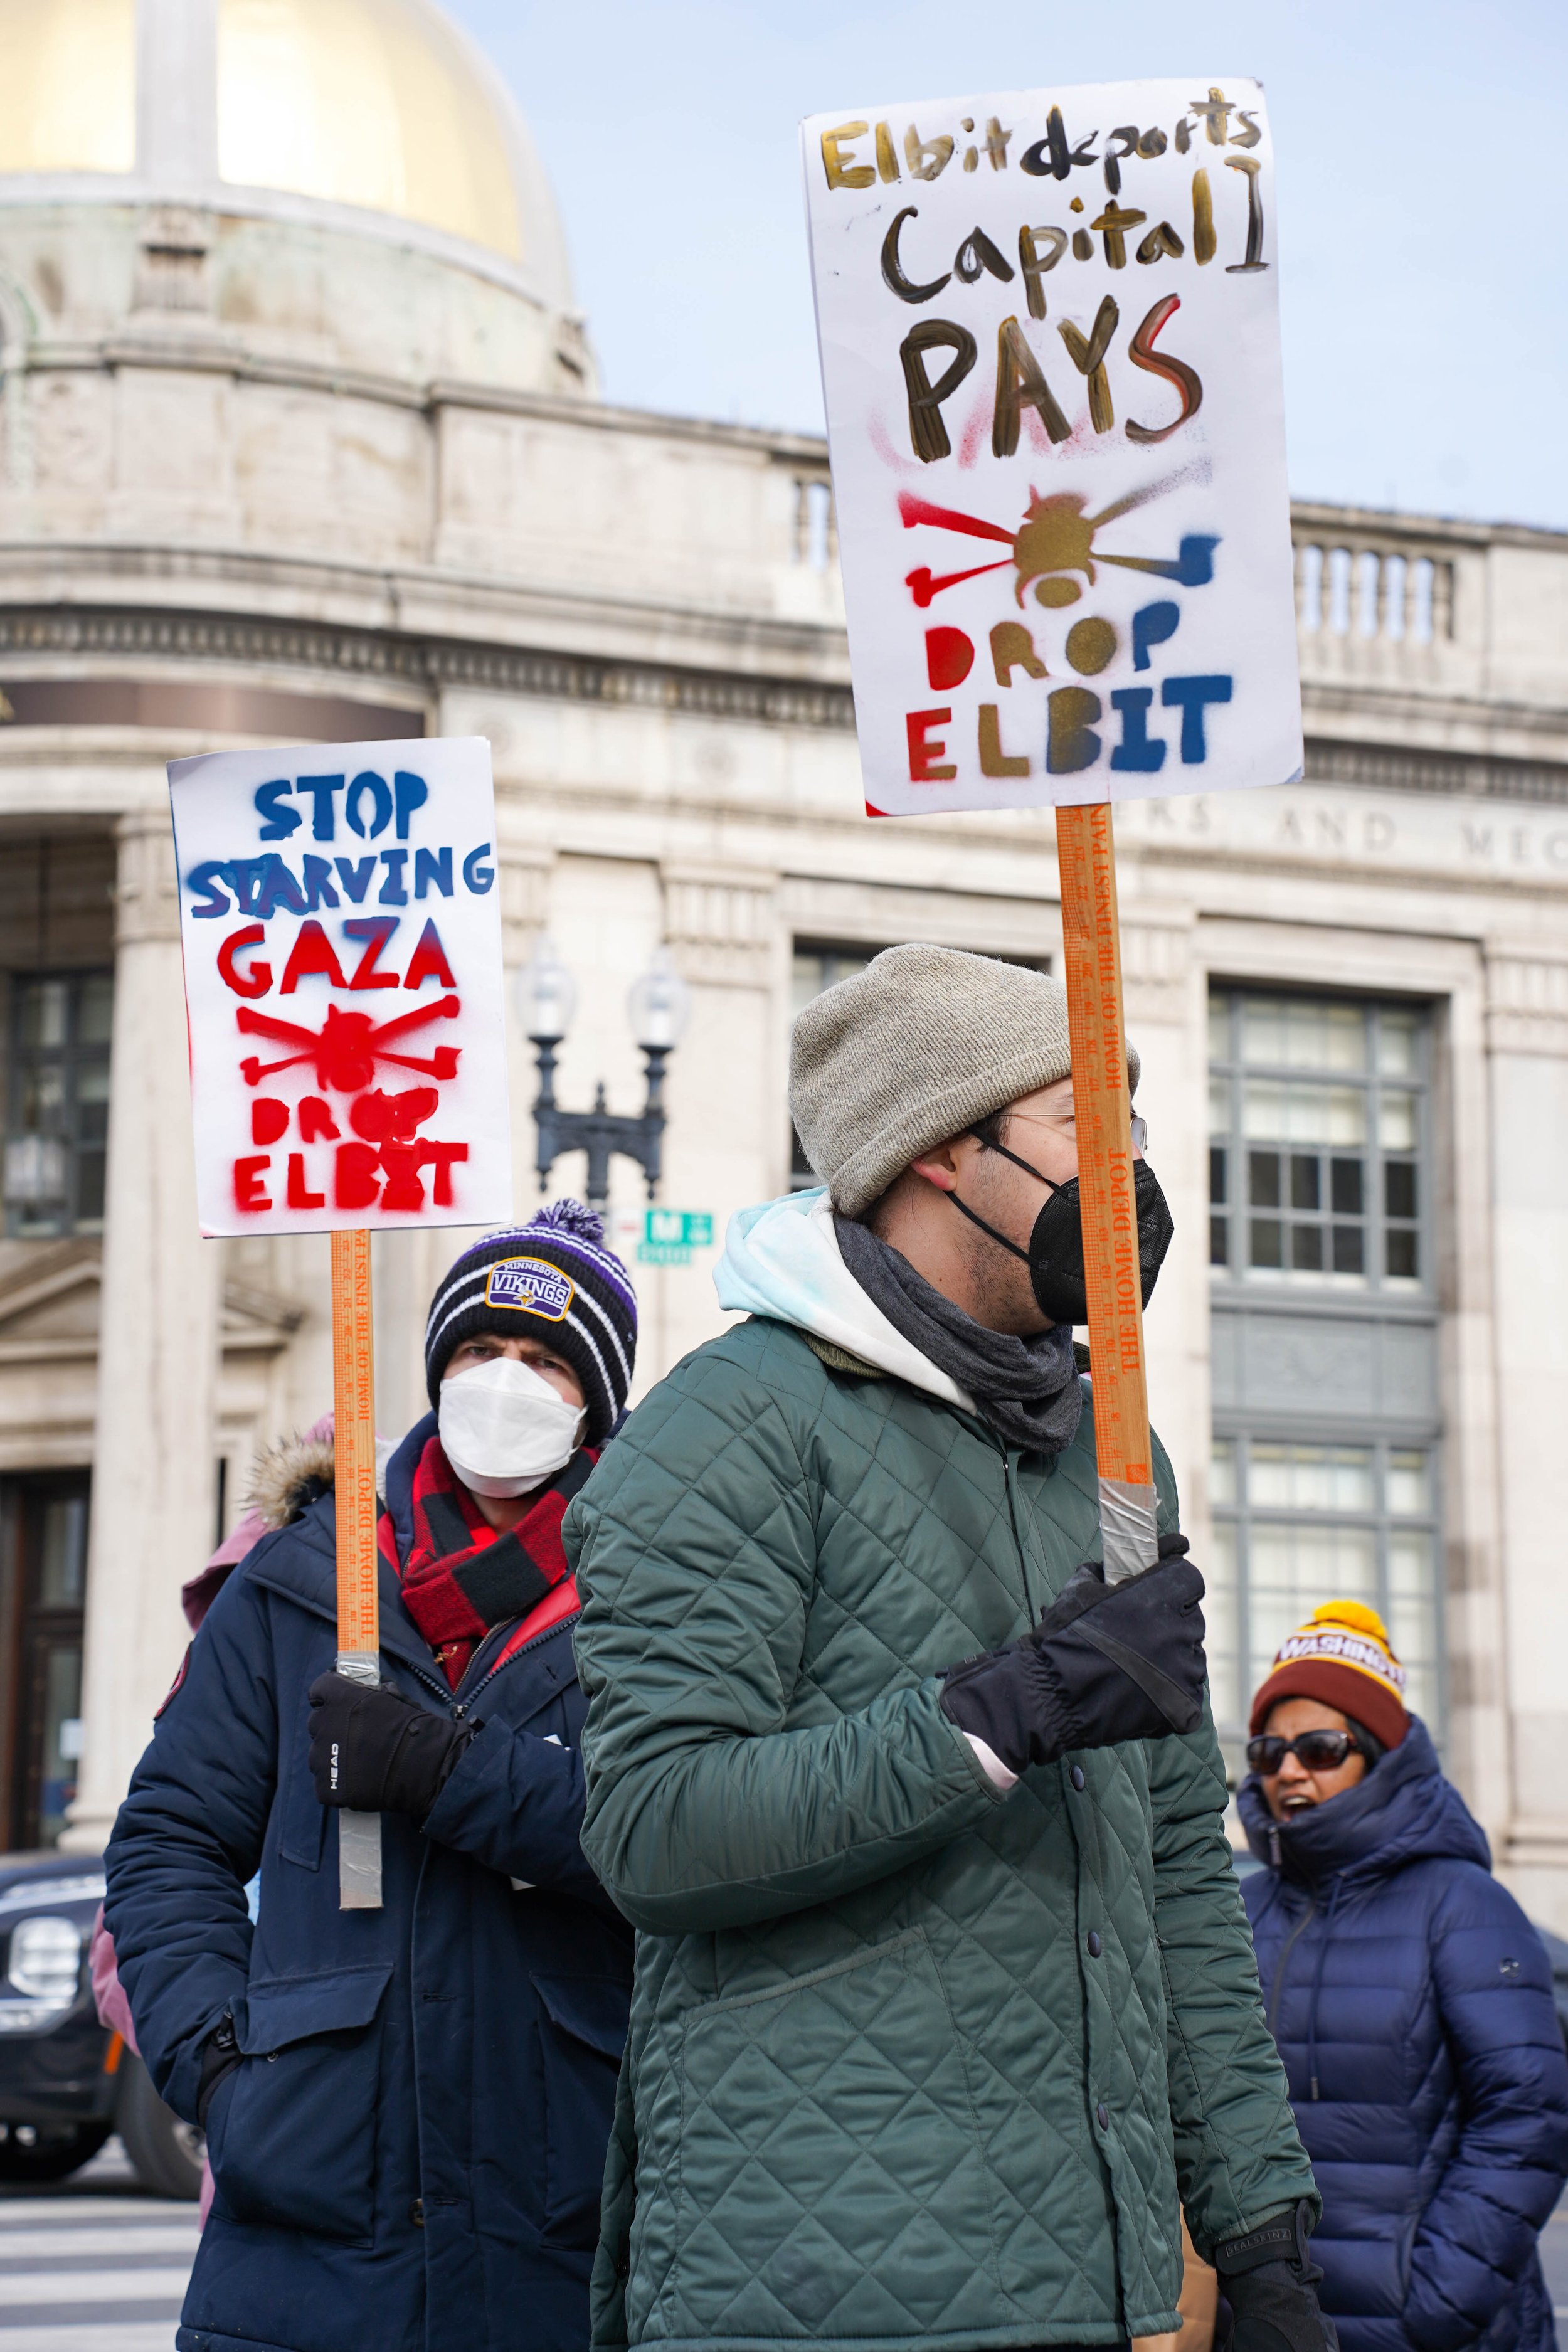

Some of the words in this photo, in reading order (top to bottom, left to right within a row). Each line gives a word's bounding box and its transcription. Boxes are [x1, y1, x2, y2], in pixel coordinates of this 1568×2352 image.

[822, 117, 1012, 190] Elbit
[1020, 87, 1261, 195] deports
[881, 167, 1217, 319] Capital
[899, 292, 1203, 464] PAYS
[925, 600, 1180, 691] DROP
[905, 675, 1233, 782] ELBIT
[254, 771, 428, 842] STOP
[185, 843, 495, 919] STARVING
[1093, 862, 1112, 936] FINEST
[216, 917, 457, 999] GAZA
[1098, 942, 1115, 986] THE
[1101, 991, 1118, 1019] OF
[1103, 1024, 1122, 1089] HOME
[252, 1087, 439, 1145] DROP
[233, 1141, 469, 1212] ELBIT
[1108, 1148, 1131, 1232] DEPOT
[355, 1251, 367, 1306] FINEST
[494, 1274, 567, 1306] VIKINGS
[504, 1261, 562, 1284] MINNESOTA
[1114, 1239, 1136, 1315] HOME
[356, 1311, 368, 1343] THE
[1120, 1323, 1140, 1375] THE
[357, 1347, 369, 1369] OF
[358, 1372, 370, 1420] HOME
[358, 1465, 372, 1527] DEPOT
[359, 1535, 373, 1593] HOME
[361, 1599, 374, 1639] THE
[331, 1743, 339, 1789] HEAD
[1227, 2230, 1288, 2254] SEALSKINZ
